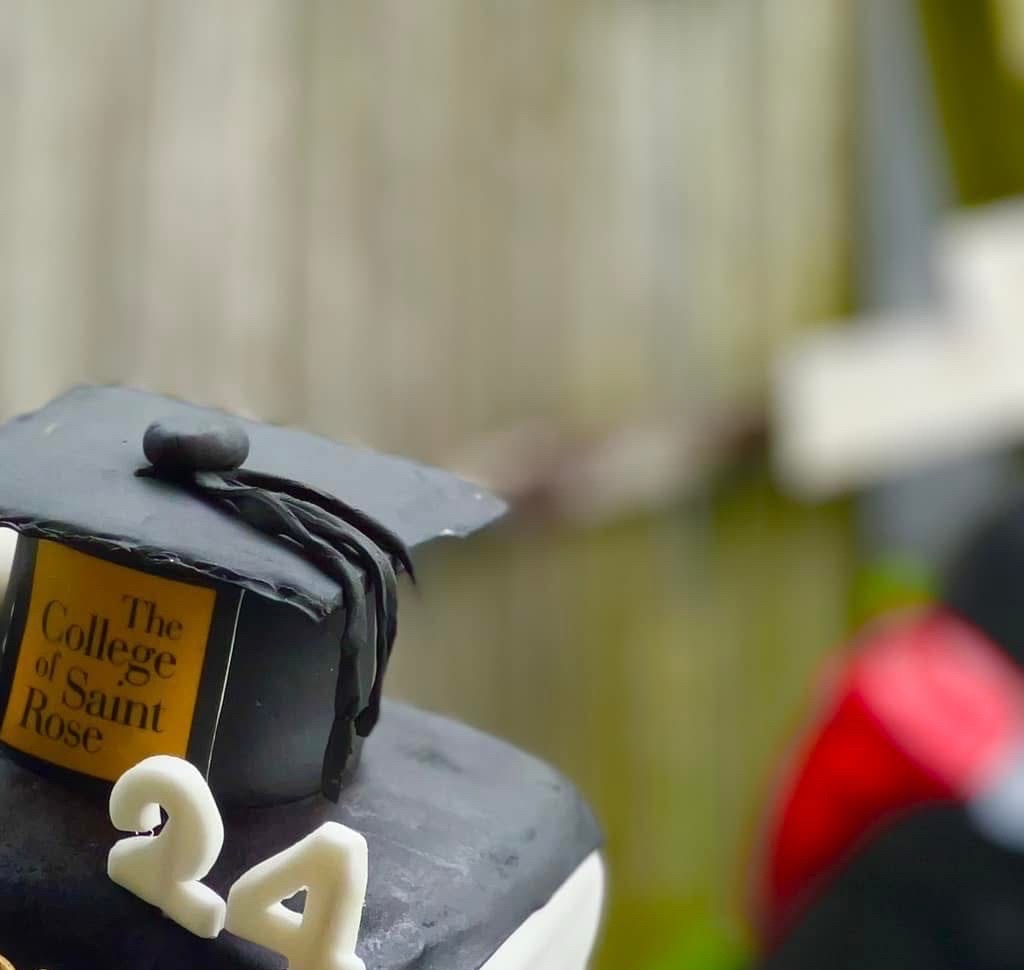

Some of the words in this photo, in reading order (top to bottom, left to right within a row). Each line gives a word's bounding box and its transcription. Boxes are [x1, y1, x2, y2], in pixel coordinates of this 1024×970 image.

[42, 600, 176, 686] College
[123, 595, 183, 640] The
[19, 687, 103, 753] Rose
[36, 652, 61, 681] of
[62, 667, 165, 732] Saint
